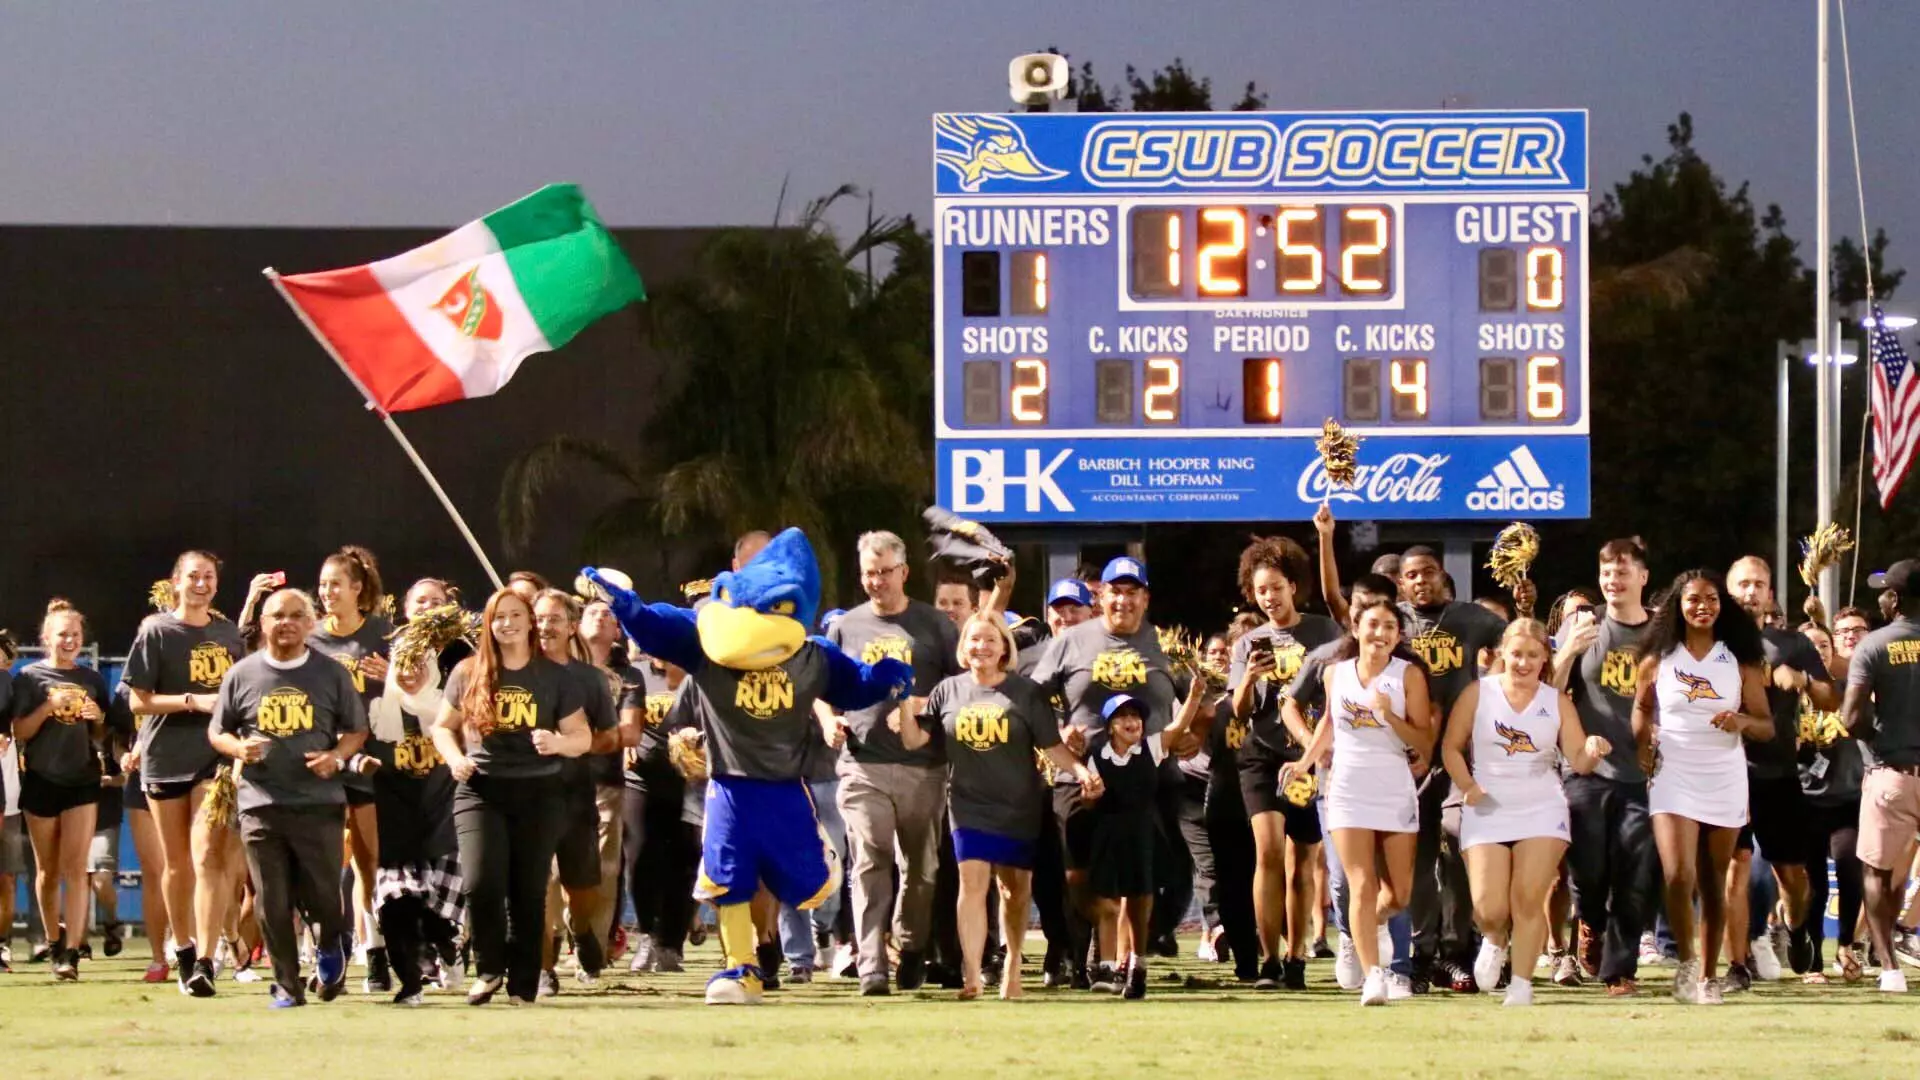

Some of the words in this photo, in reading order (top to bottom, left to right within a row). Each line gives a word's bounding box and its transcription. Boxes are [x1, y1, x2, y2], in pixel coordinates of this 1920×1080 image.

[1089, 127, 1275, 180] CSUB
[1284, 125, 1557, 179] SOCCER
[942, 208, 1110, 247] RUNNERS
[1454, 204, 1580, 244] GUEST
[1167, 207, 1388, 292] 12:52
[1034, 253, 1047, 311] 1
[1526, 247, 1564, 309] 0
[962, 325, 1049, 354] SHOTS
[1088, 326, 1112, 353] C.
[1118, 325, 1189, 353] KICKS
[1213, 325, 1311, 353] PERIOD
[1335, 325, 1359, 352] C.
[1365, 324, 1436, 352] KICKS
[1477, 323, 1566, 351] SHOTS
[1011, 358, 1047, 422] 2
[1143, 357, 1180, 421] 2
[1266, 359, 1281, 418] 1
[1390, 360, 1428, 416] 4
[1527, 355, 1564, 419] 6
[1078, 457, 1142, 472] BARBICH
[1148, 456, 1211, 471] HOOPER
[1217, 456, 1256, 471] KING
[1297, 452, 1451, 503] Coa-Cola
[950, 448, 1077, 514] BHK
[1109, 473, 1142, 487] DILL
[1149, 473, 1223, 487] HOFFMAN
[1091, 492, 1164, 502] ACCOUNTANCY
[1168, 492, 1240, 502] CORPORATION
[1465, 486, 1566, 511] adidas
[1410, 636, 1457, 649] ROWDY
[1092, 660, 1147, 684] RUN
[1416, 646, 1463, 672] UN
[1600, 661, 1638, 687] RU
[261, 694, 309, 707] ROWDY
[494, 692, 533, 704] OWDY
[735, 680, 794, 710] RUN
[257, 704, 313, 731] RUN
[495, 702, 538, 728] UN
[955, 716, 1009, 743] RUN
